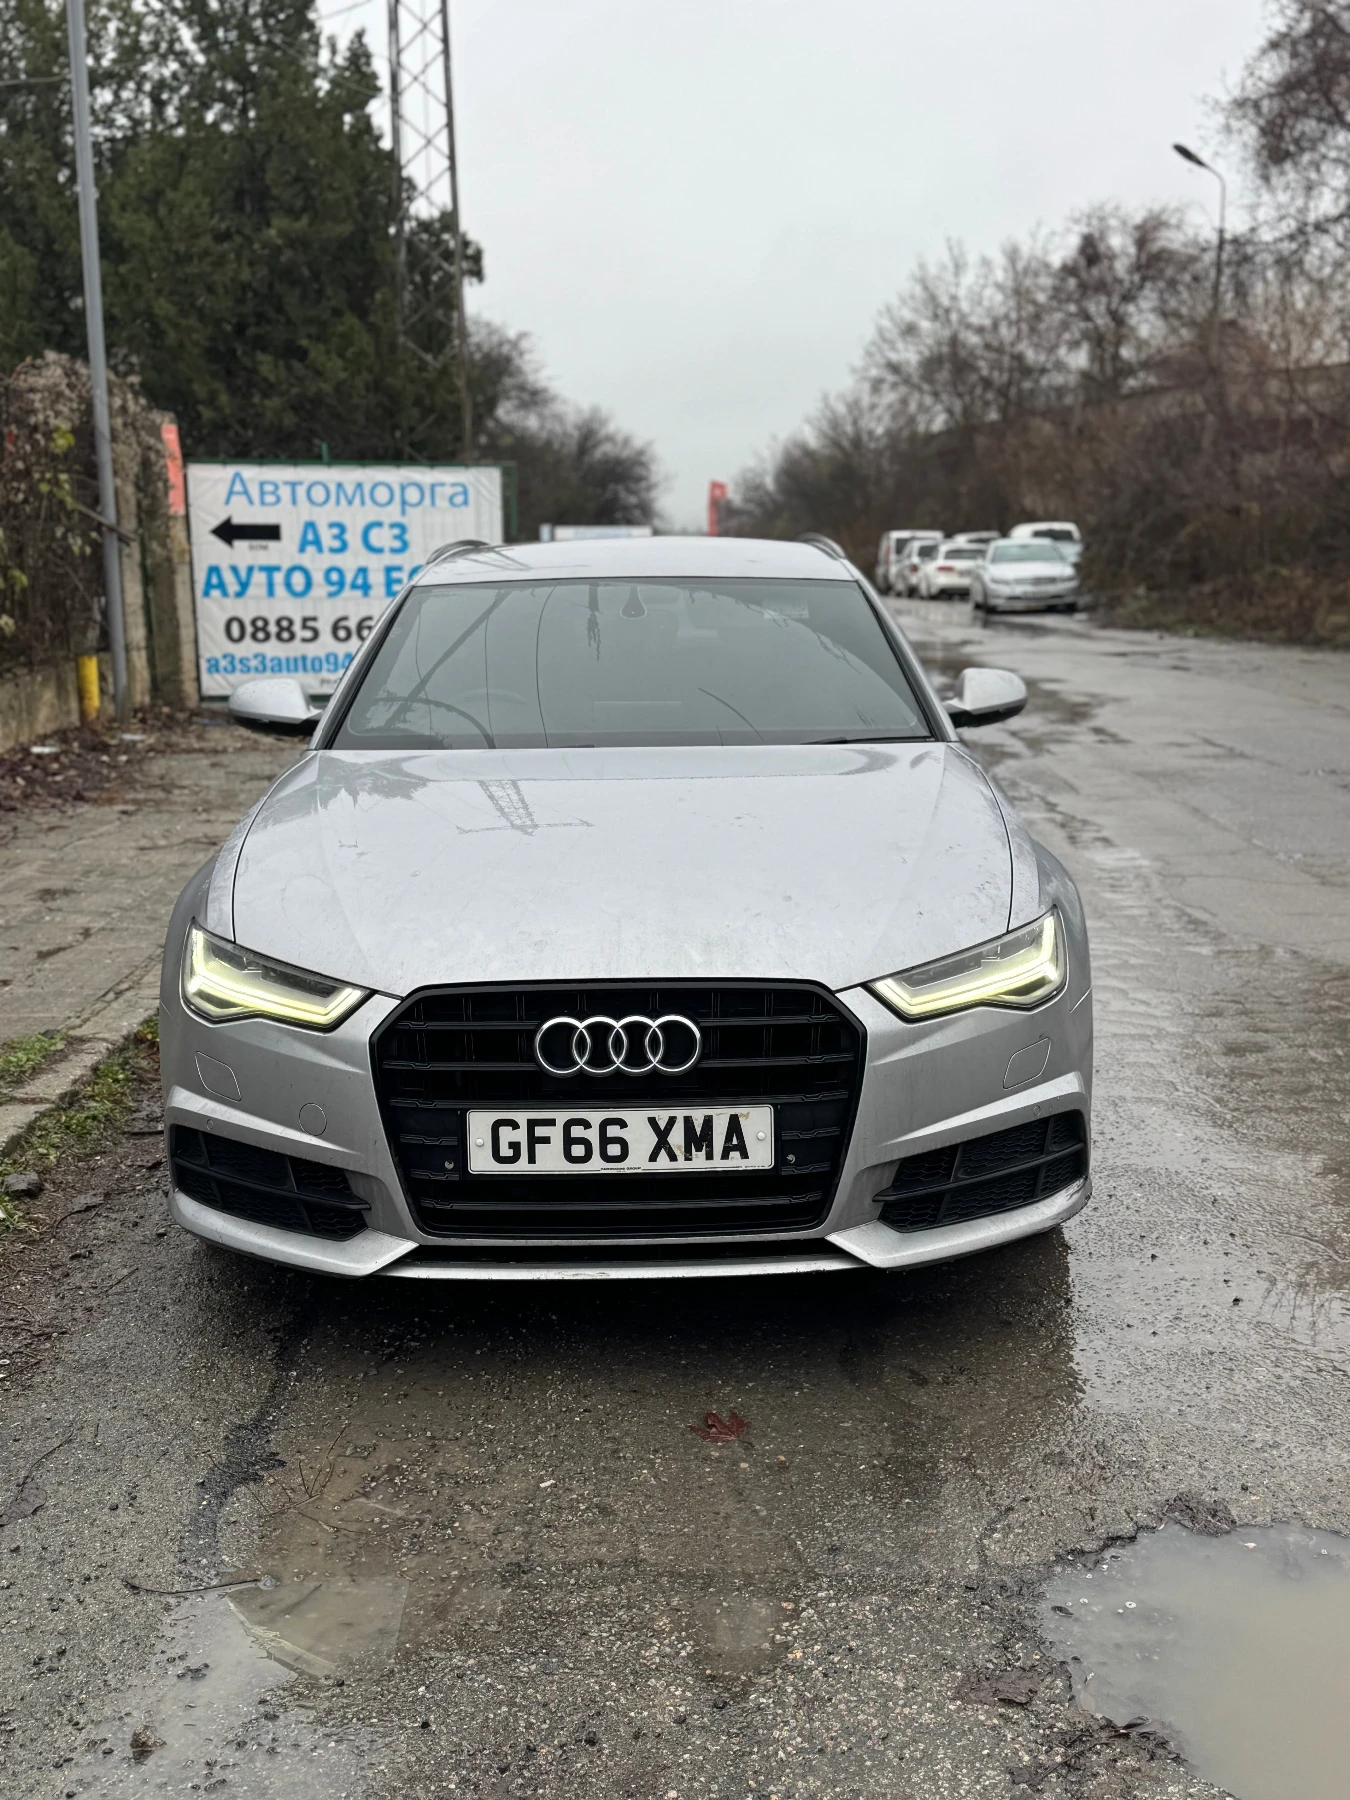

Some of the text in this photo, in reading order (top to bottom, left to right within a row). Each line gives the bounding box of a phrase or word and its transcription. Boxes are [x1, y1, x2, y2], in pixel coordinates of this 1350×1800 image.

[225, 472, 468, 516] Автоморга
[202, 565, 312, 598] АУТО
[323, 565, 372, 598] 94
[225, 616, 319, 643] 0885
[491, 1114, 749, 1164] GF66 XMA
